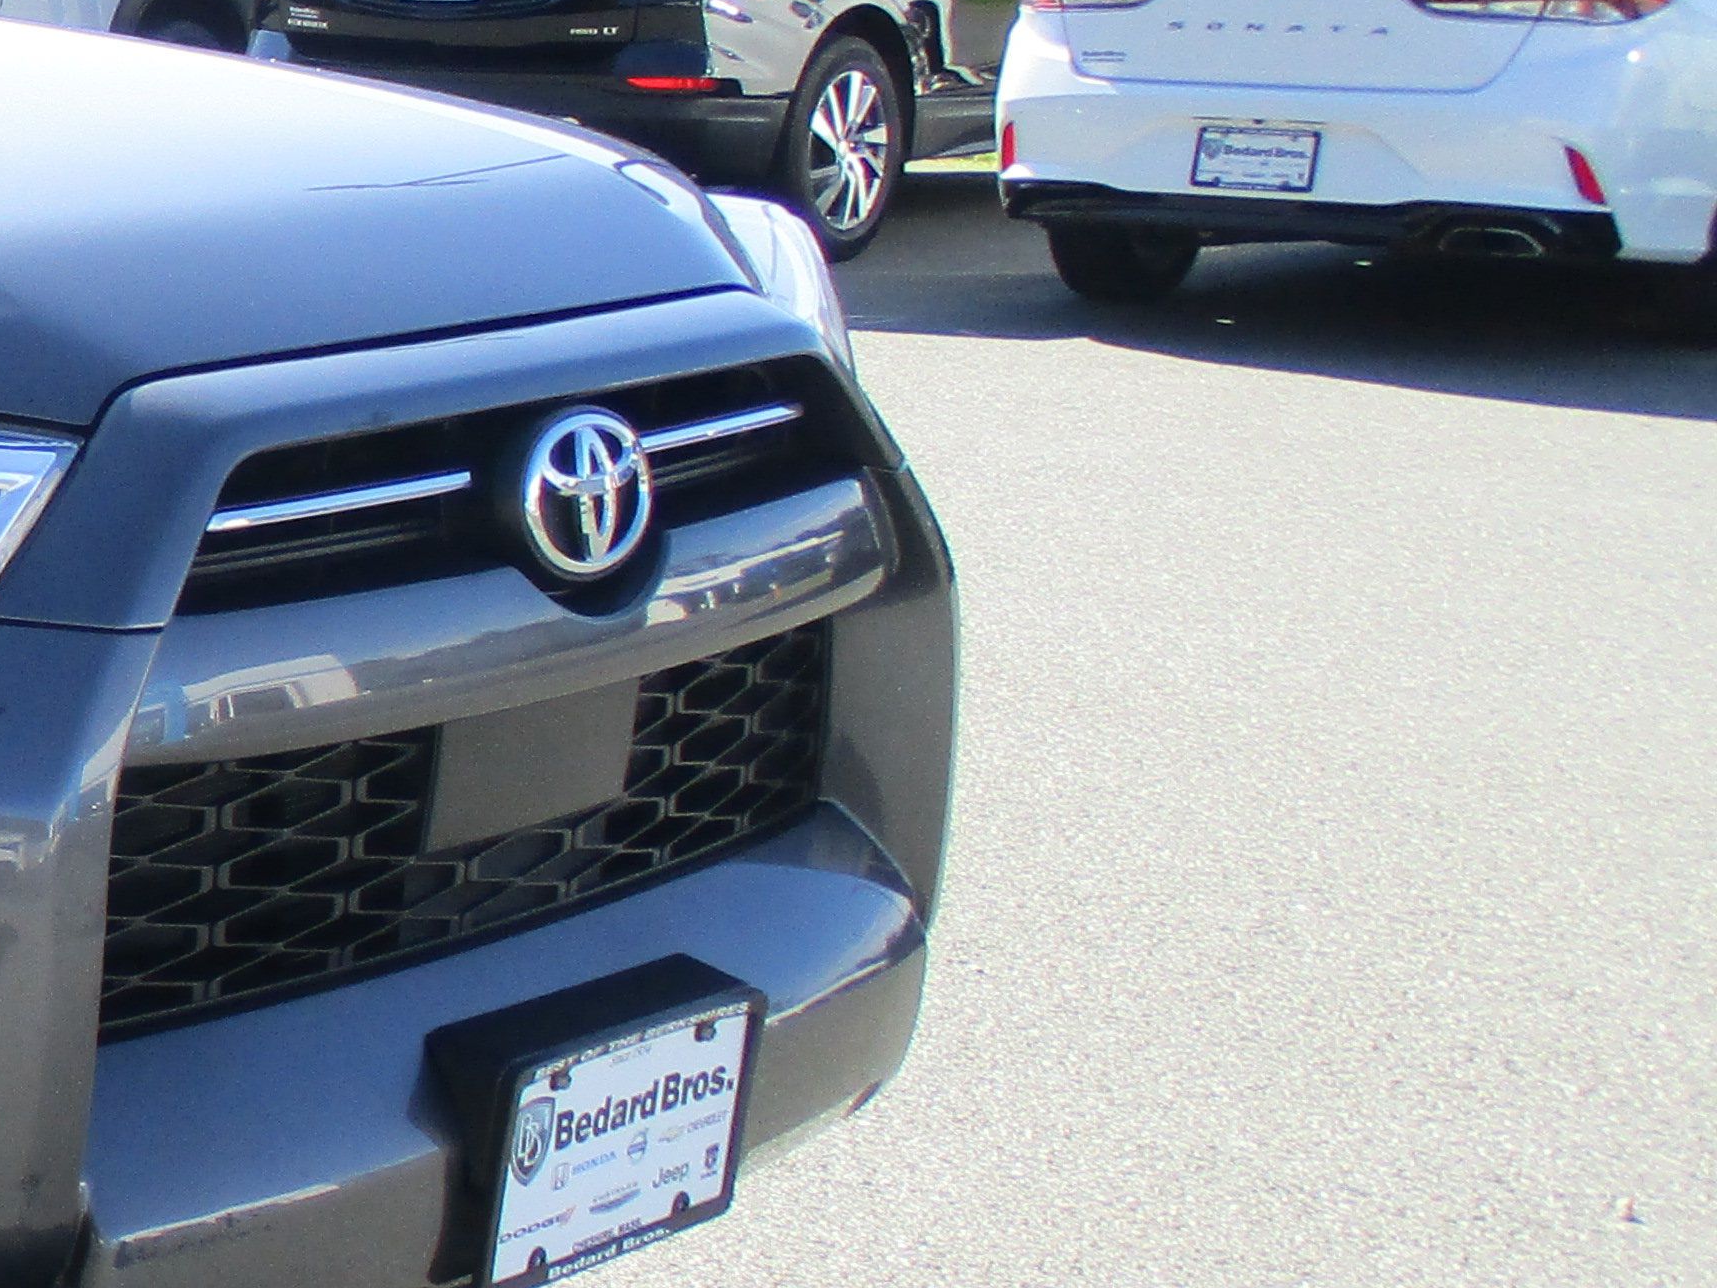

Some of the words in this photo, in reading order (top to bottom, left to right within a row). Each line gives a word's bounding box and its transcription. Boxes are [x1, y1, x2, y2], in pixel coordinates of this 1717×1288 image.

[1168, 20, 1389, 35] SONATA
[580, 1044, 609, 1062] OF
[608, 1031, 645, 1051] THE
[553, 1078, 660, 1151] Bedard
[659, 1065, 735, 1112] Bros.
[572, 1150, 617, 1175] HONDA
[652, 1163, 690, 1188] Jeep
[499, 1214, 564, 1244] DODGE
[550, 1244, 617, 1279] Bedard
